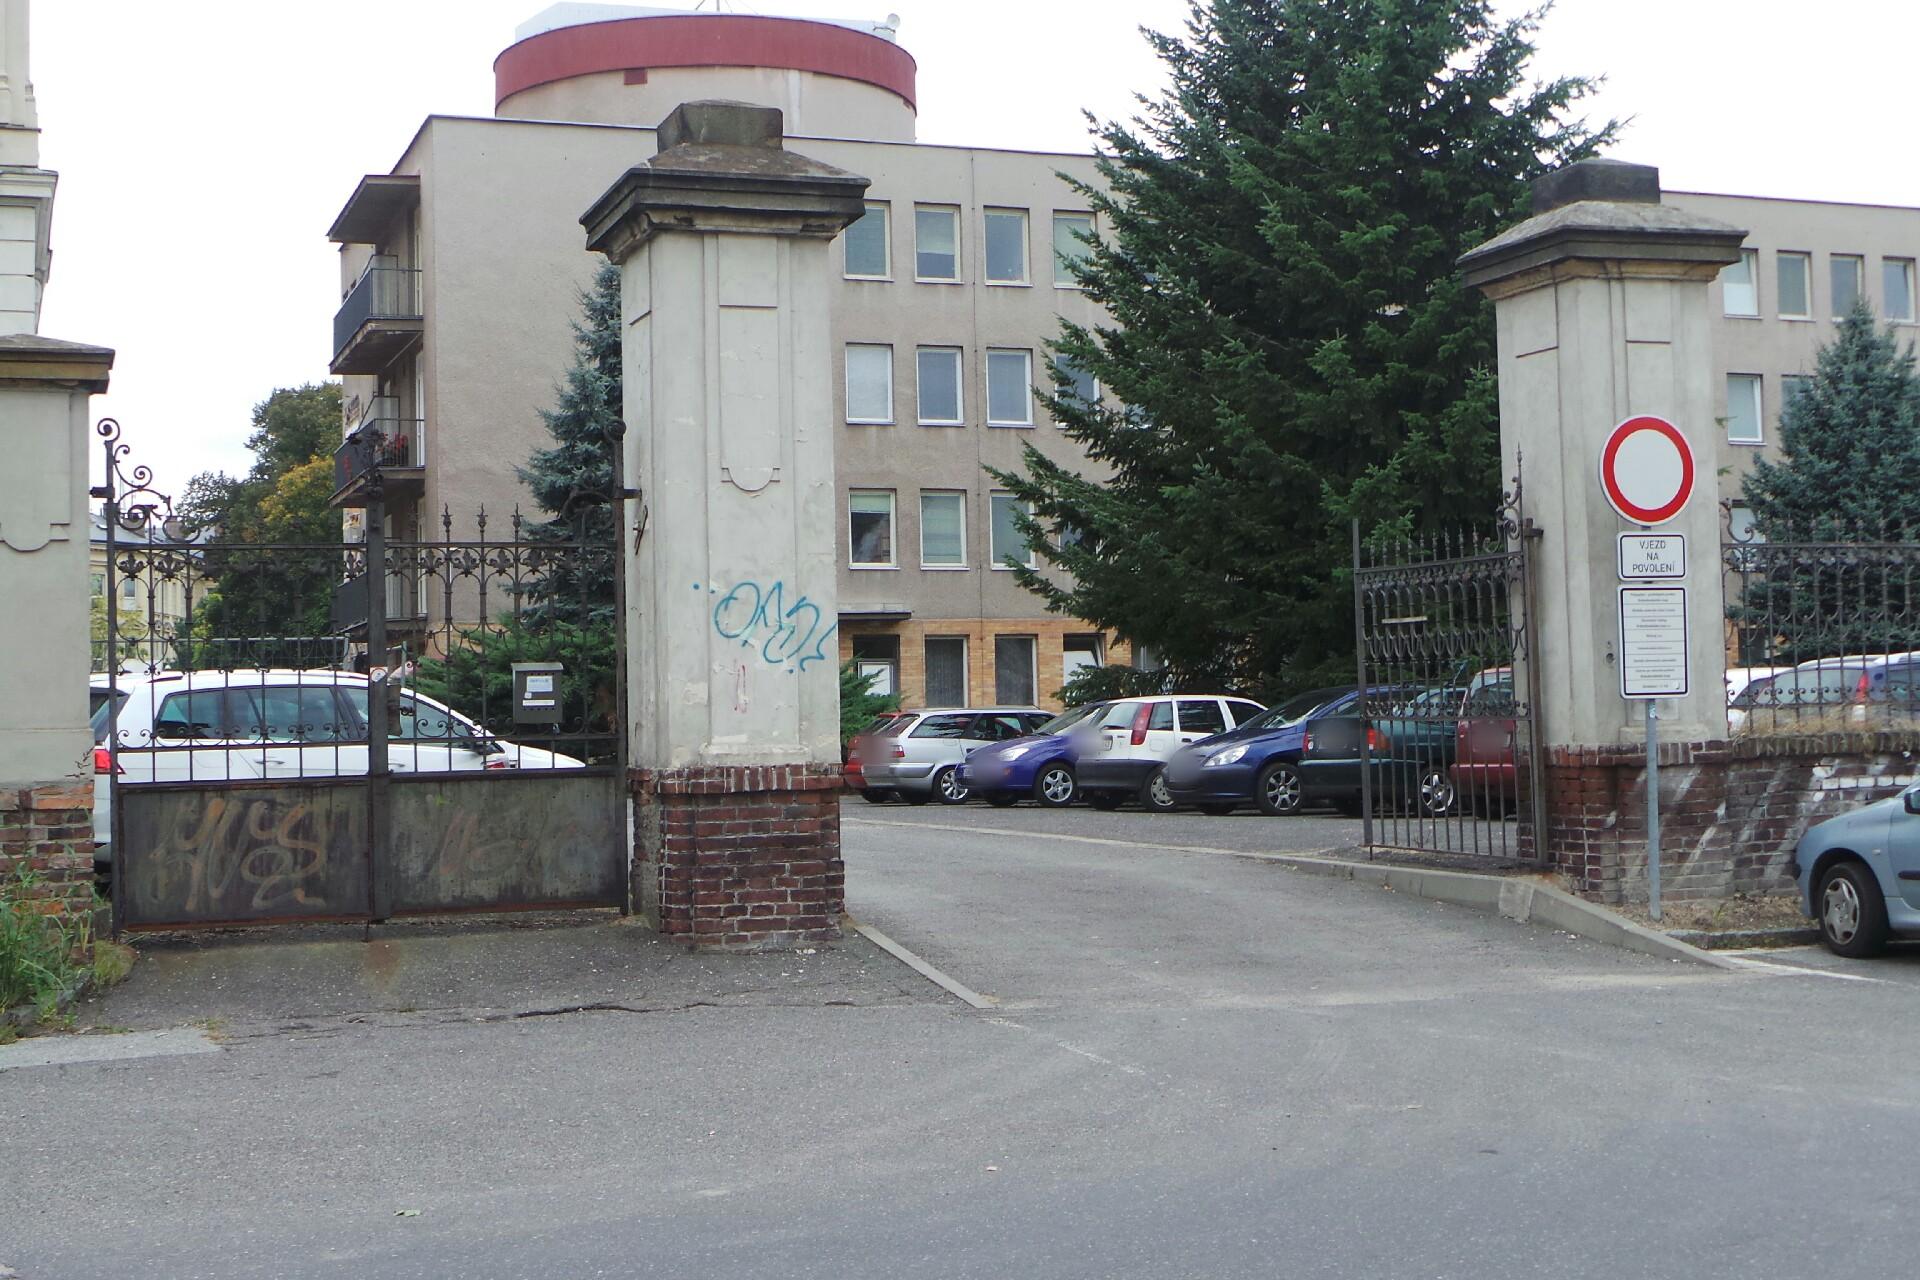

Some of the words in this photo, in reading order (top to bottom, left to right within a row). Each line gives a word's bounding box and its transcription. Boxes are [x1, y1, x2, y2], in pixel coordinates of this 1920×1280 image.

[1640, 540, 1666, 549] VJEZD
[1646, 552, 1659, 561] NA
[1632, 561, 1675, 573] POVOLENÍ
